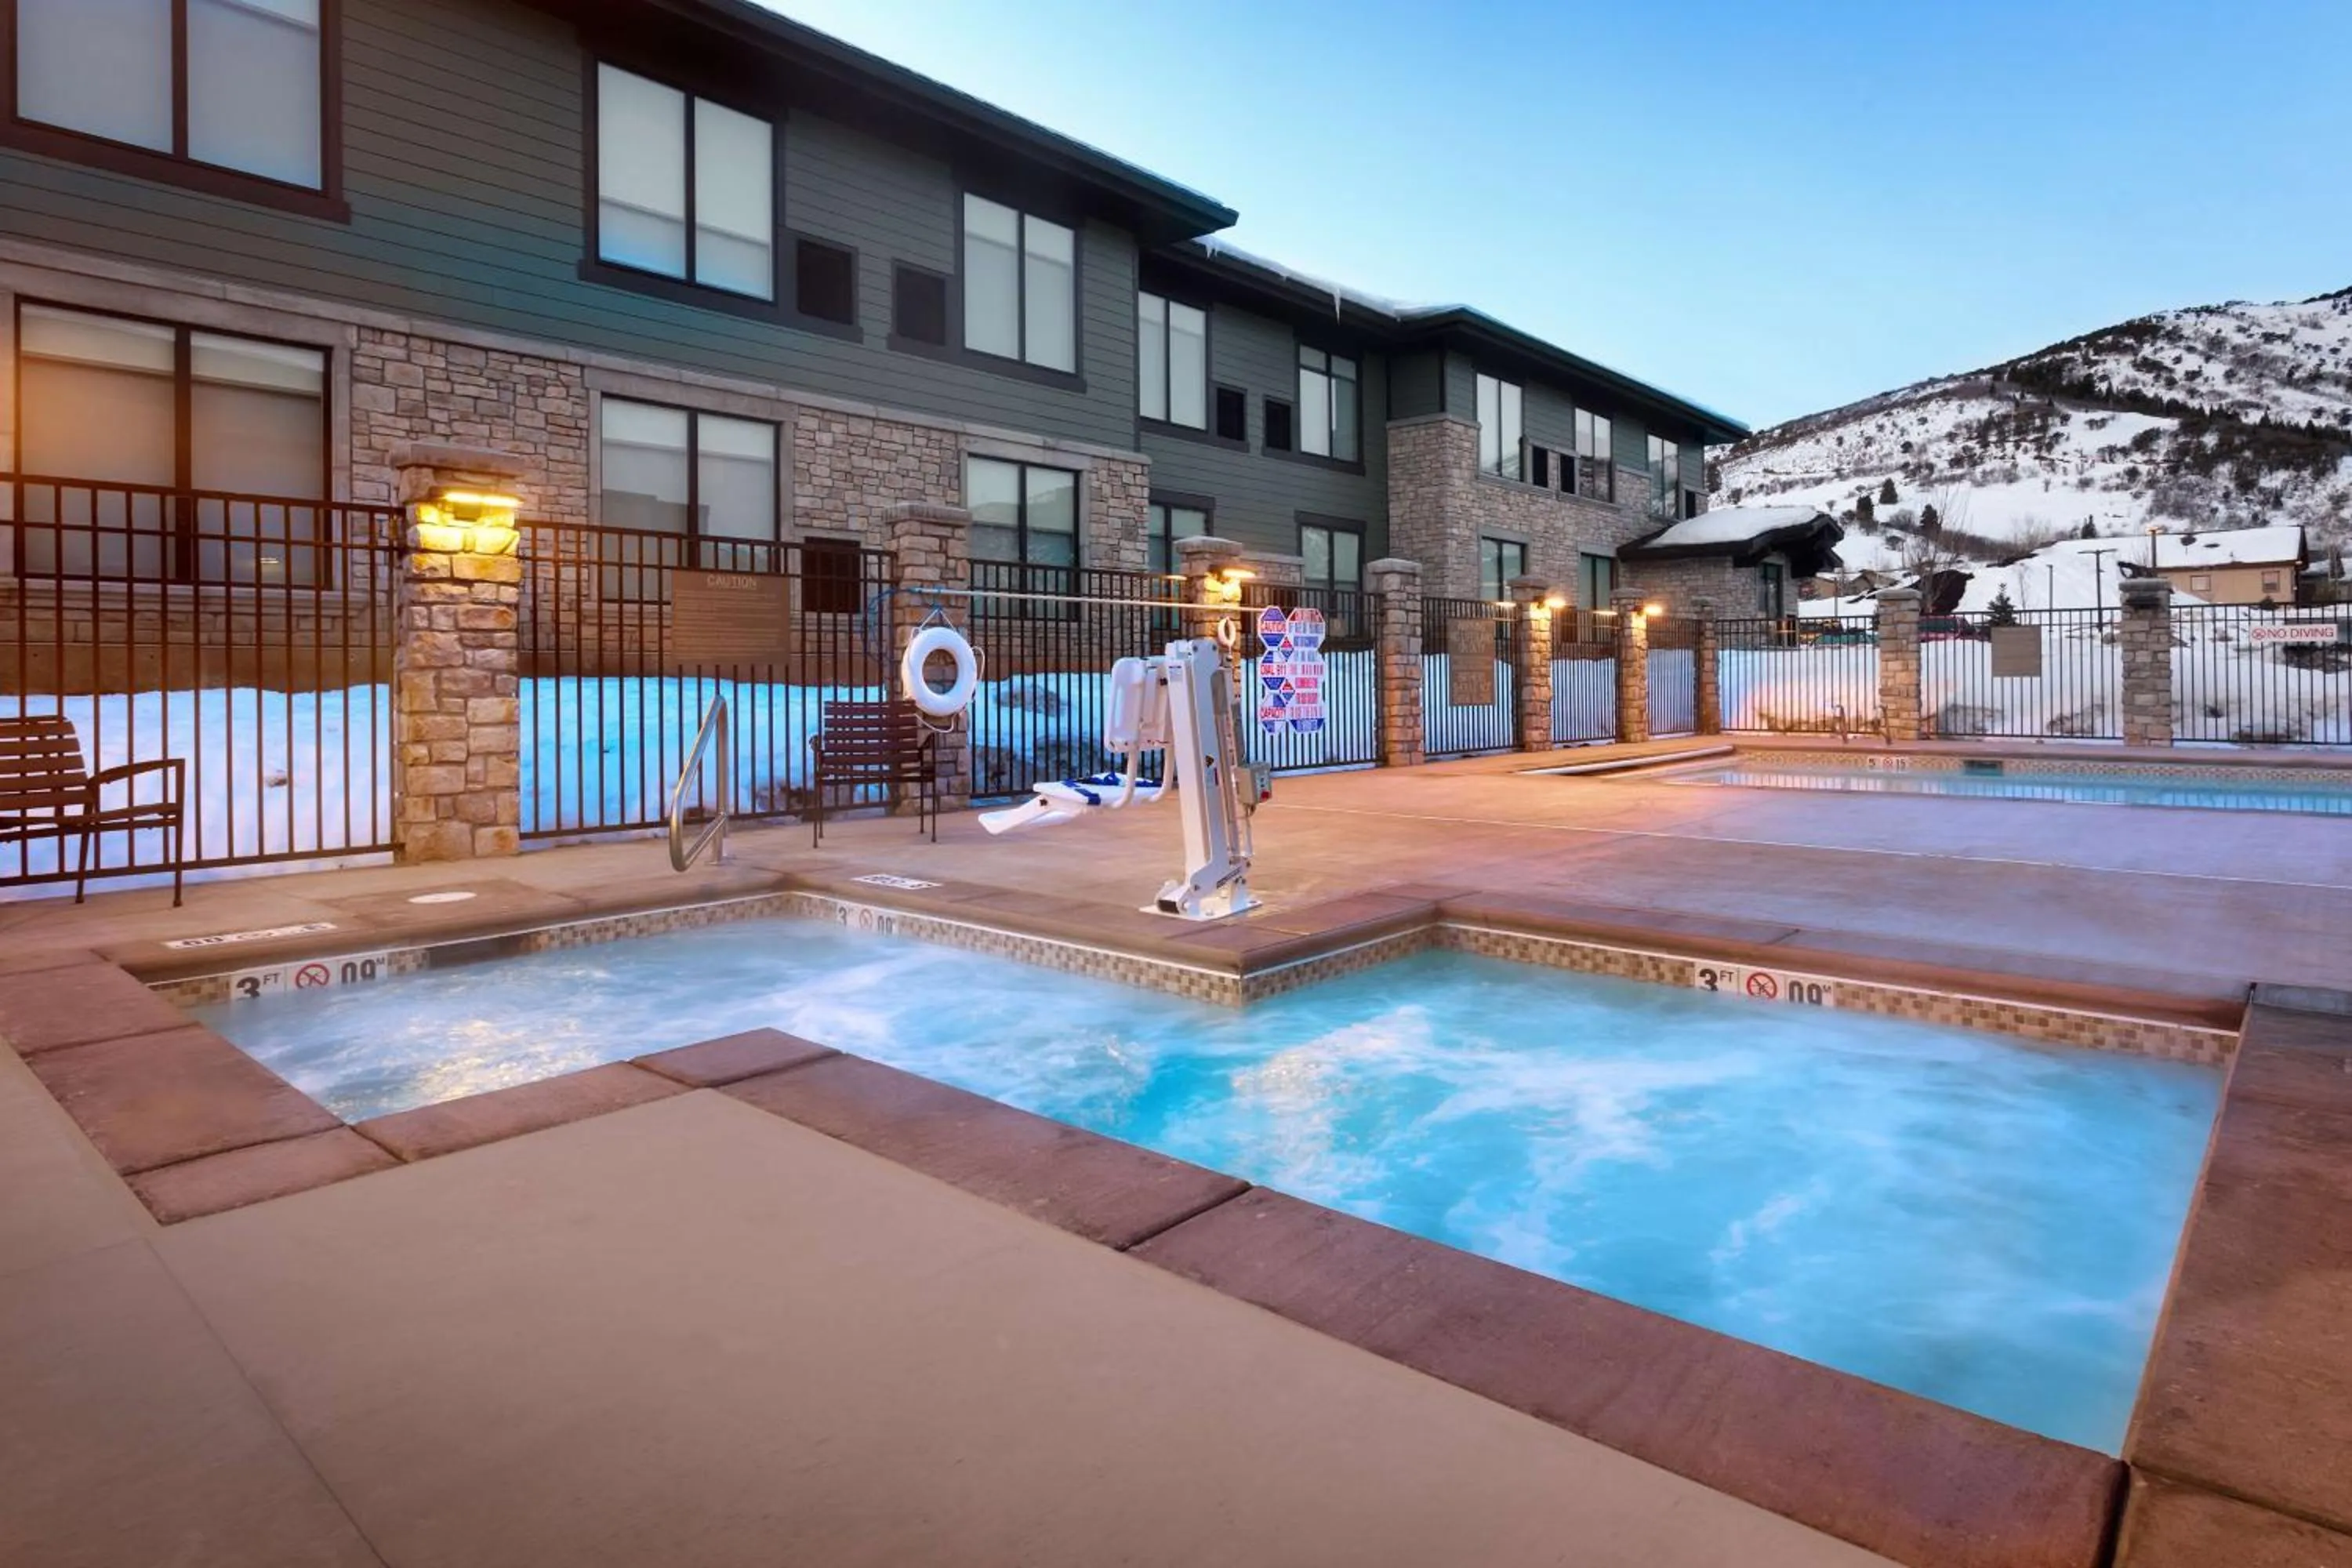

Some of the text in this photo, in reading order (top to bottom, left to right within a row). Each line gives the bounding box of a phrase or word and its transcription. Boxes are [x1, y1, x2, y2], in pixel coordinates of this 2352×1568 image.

[707, 574, 757, 590] CAUTION
[2267, 626, 2334, 638] NO DIVING
[237, 972, 281, 999] 3 FT
[1699, 968, 1734, 992] 3 FT
